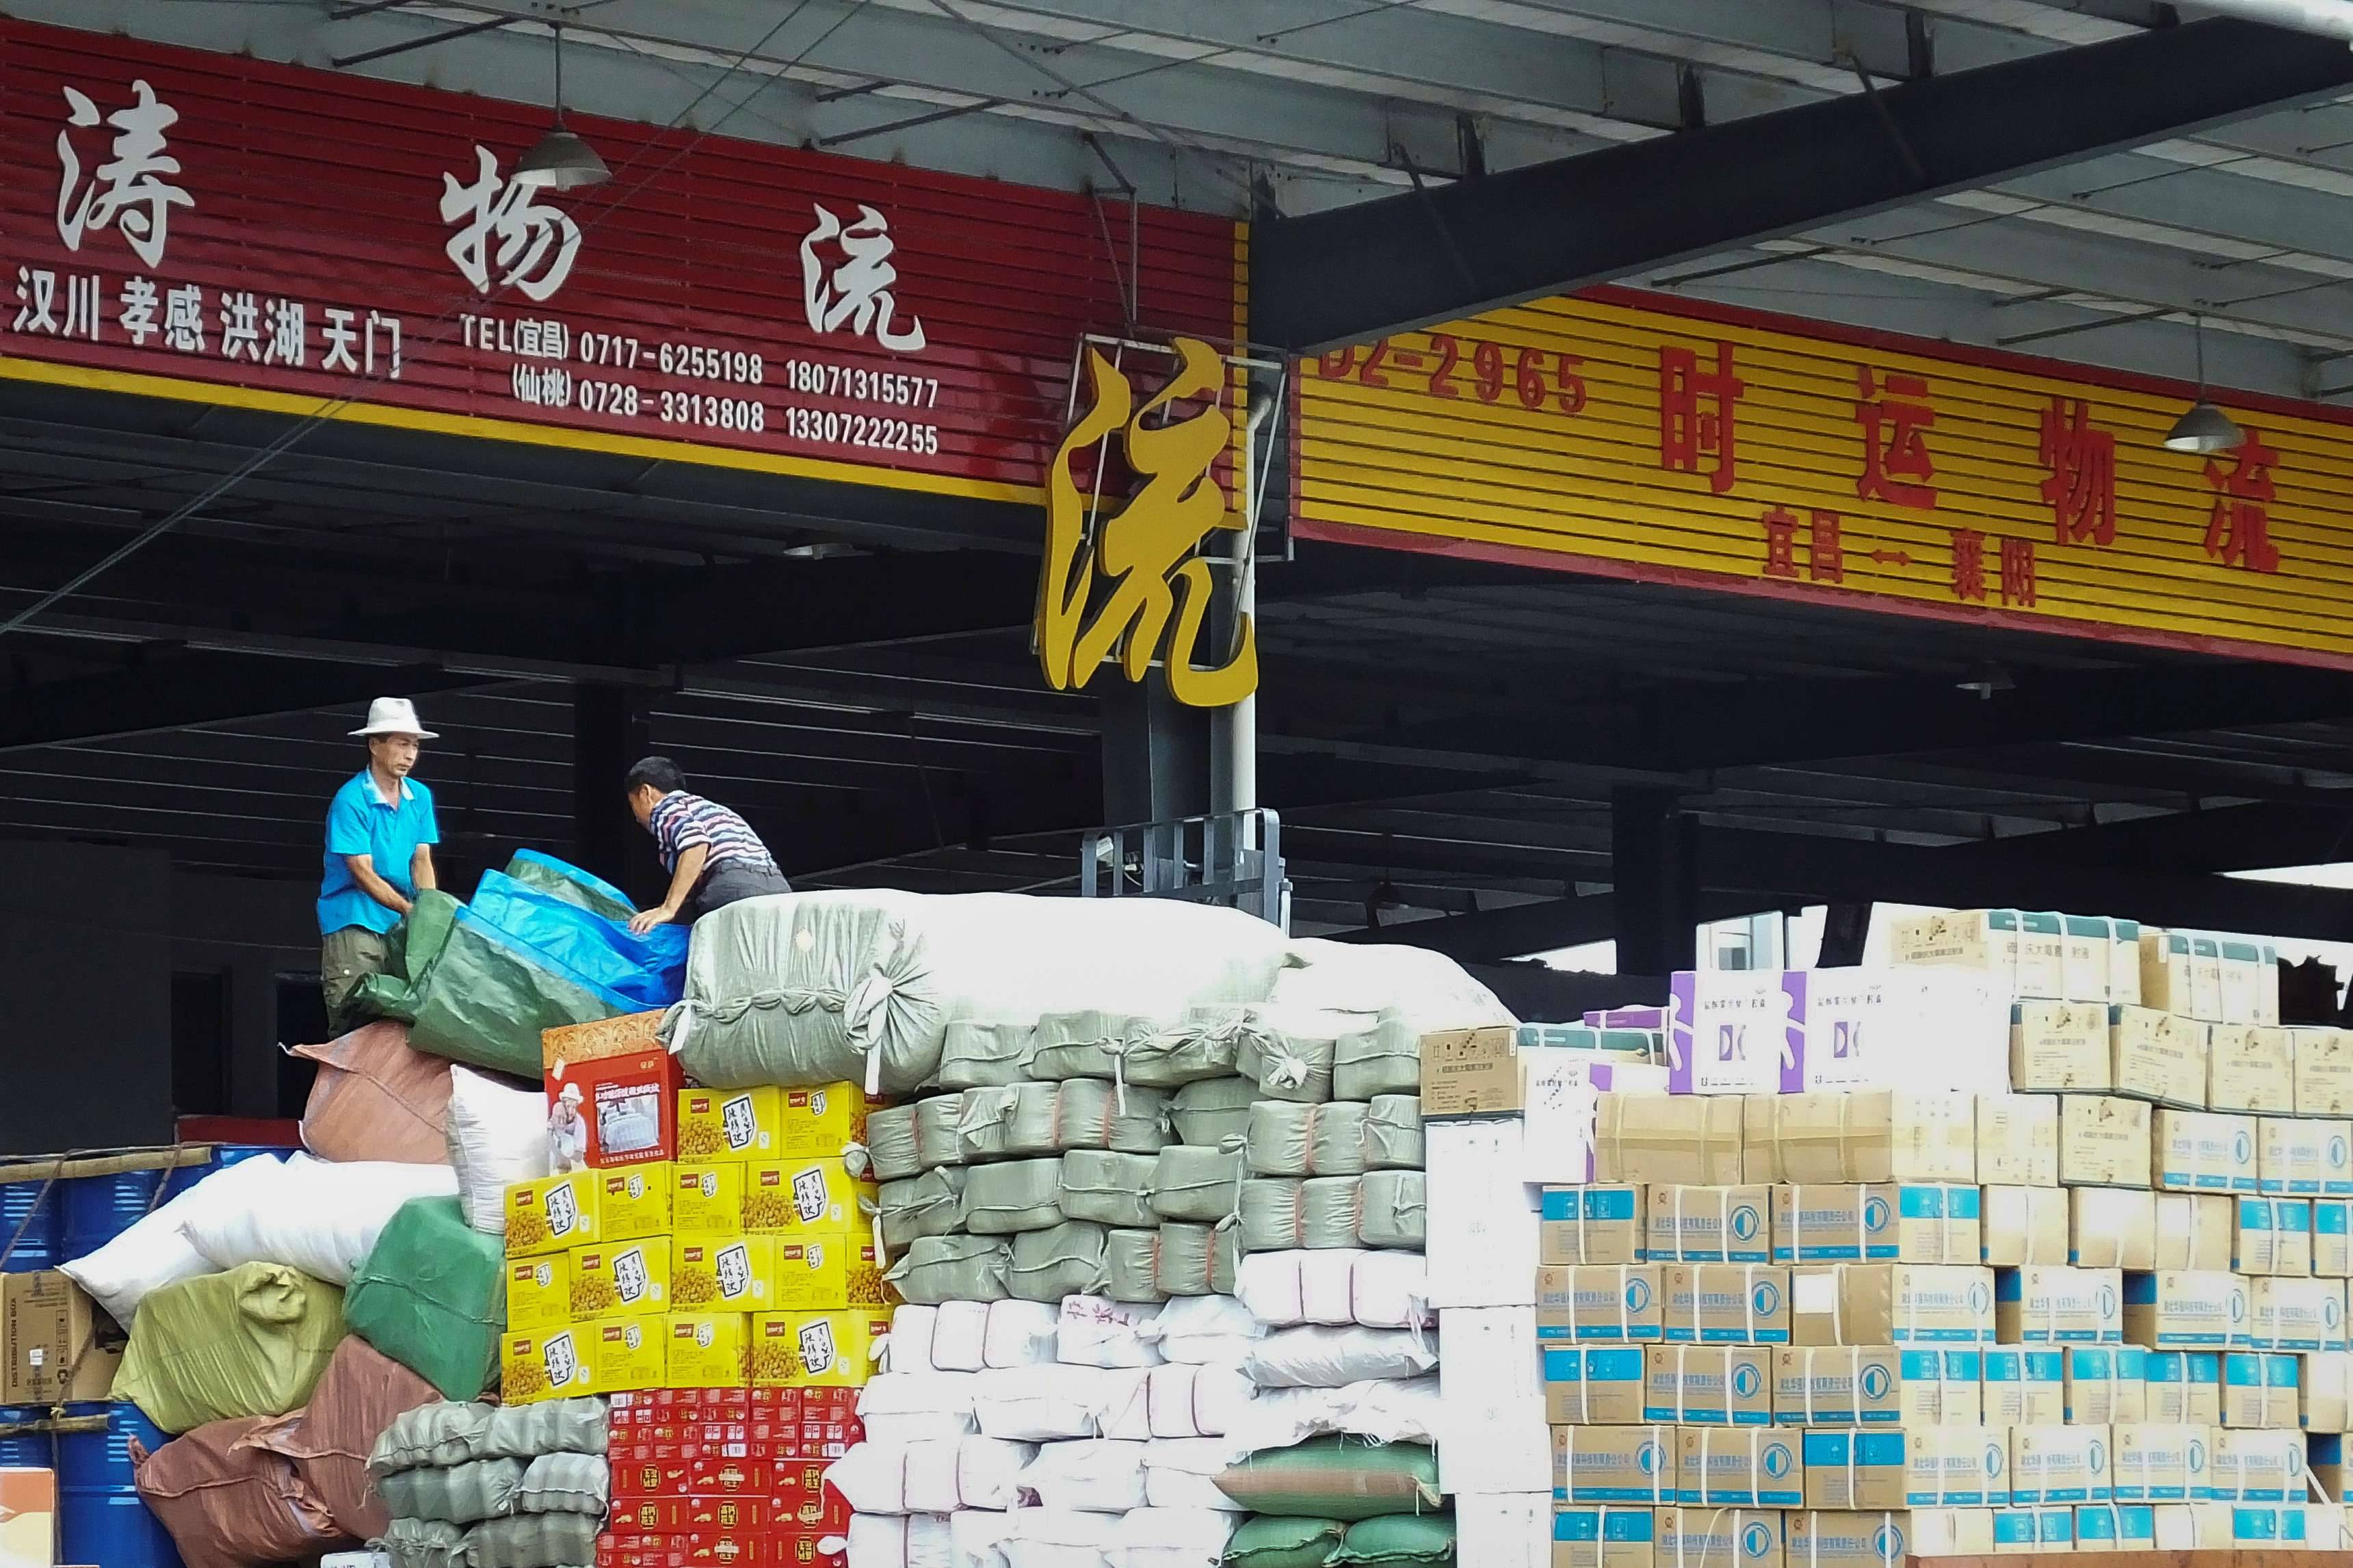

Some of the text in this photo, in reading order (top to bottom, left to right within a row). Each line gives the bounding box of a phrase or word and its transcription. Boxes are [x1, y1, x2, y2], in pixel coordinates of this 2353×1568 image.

[56, 79, 926, 351] 涛 物 流
[12, 265, 402, 380] 汉川 孝感 洪湖 天门
[581, 331, 763, 384] 0717-6255198
[787, 359, 939, 409] 18071315577
[579, 379, 763, 432] 0728-3313808
[787, 407, 939, 455] 13307222255
[1661, 341, 2280, 572] 时 运 物 流
[1040, 337, 1258, 707] 流
[1763, 505, 1844, 584] 宜昌
